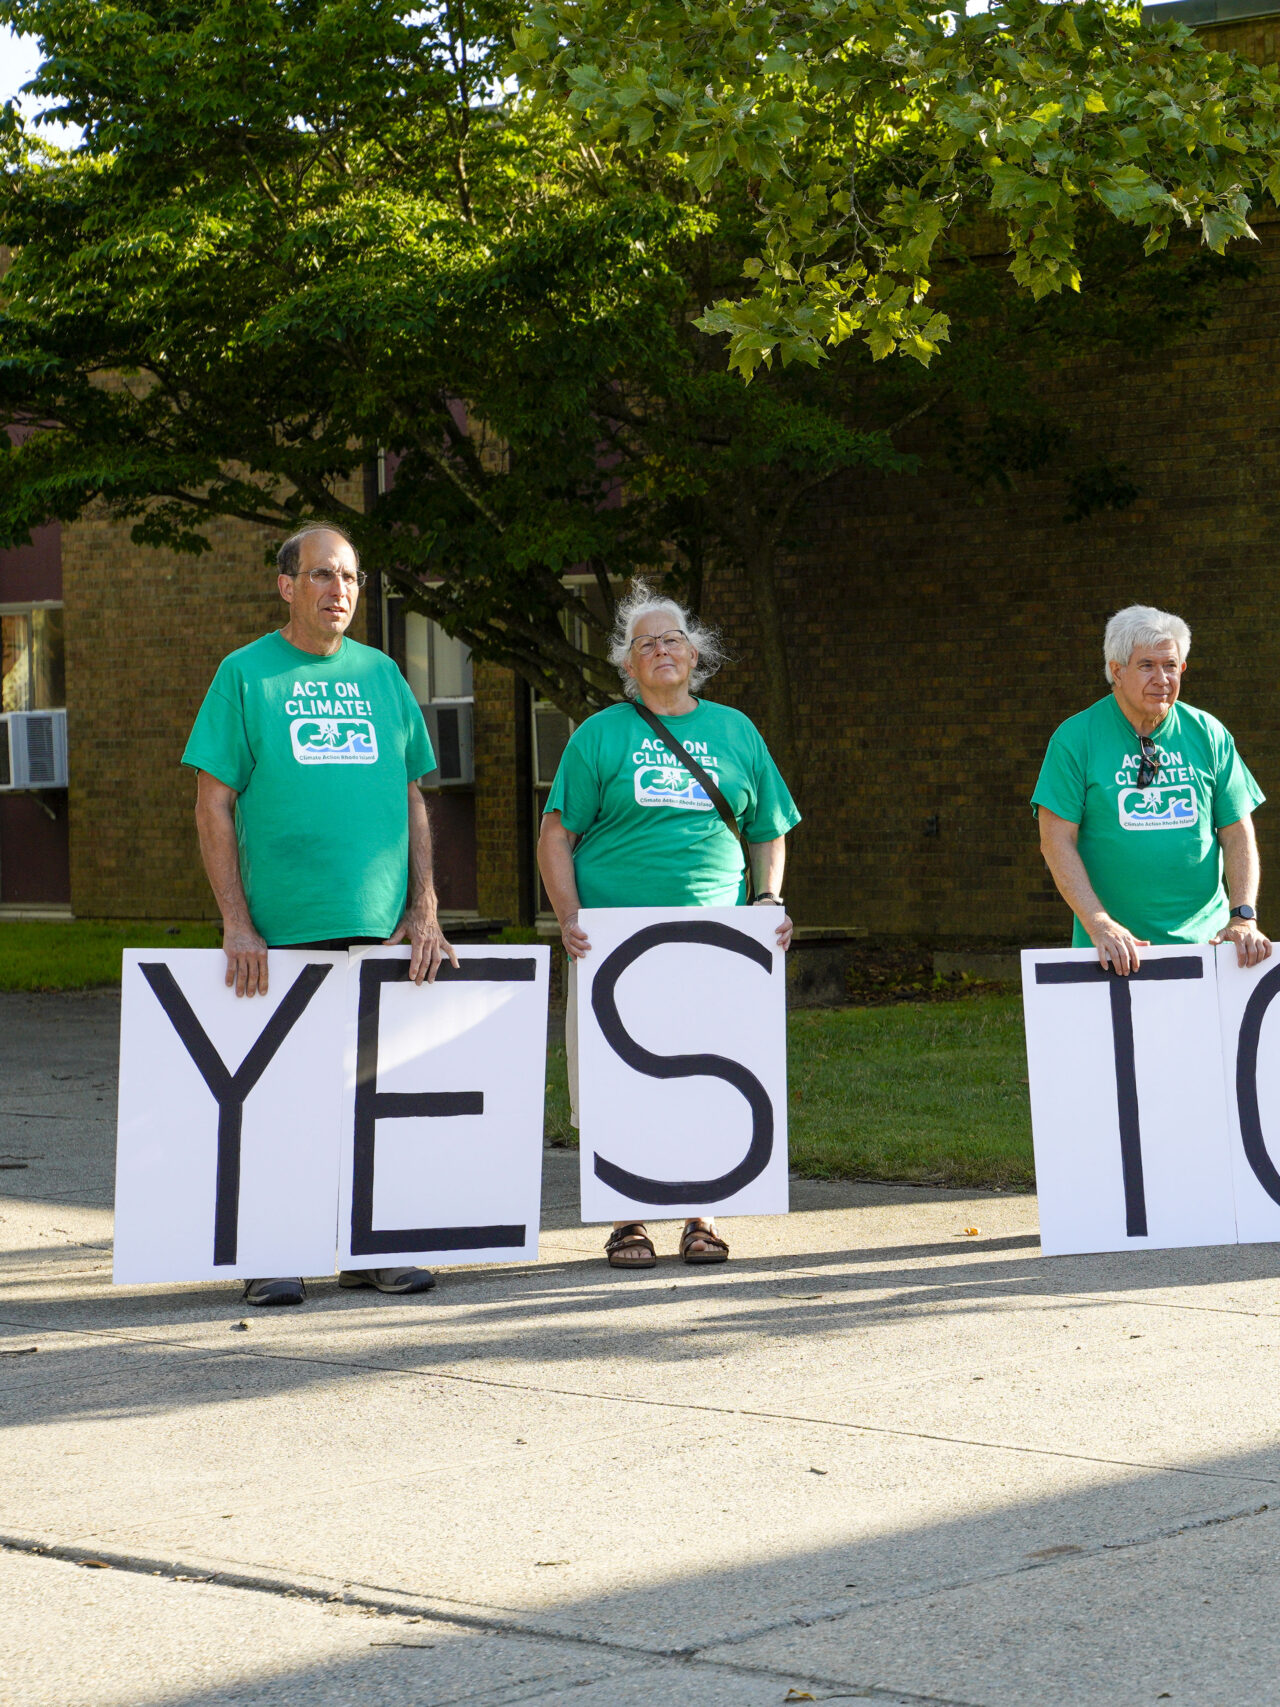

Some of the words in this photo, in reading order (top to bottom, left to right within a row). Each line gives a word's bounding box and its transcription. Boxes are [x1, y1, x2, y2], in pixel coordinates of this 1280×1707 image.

[293, 681, 328, 697] ACT
[335, 682, 360, 698] ON
[285, 700, 372, 716] CLIMATE!
[641, 738, 664, 751] AC
[683, 740, 708, 754] ON
[632, 752, 718, 767] CLIME!
[1159, 752, 1183, 766] ON
[1115, 766, 1194, 786] CLMATE!
[138, 920, 774, 1266] YES
